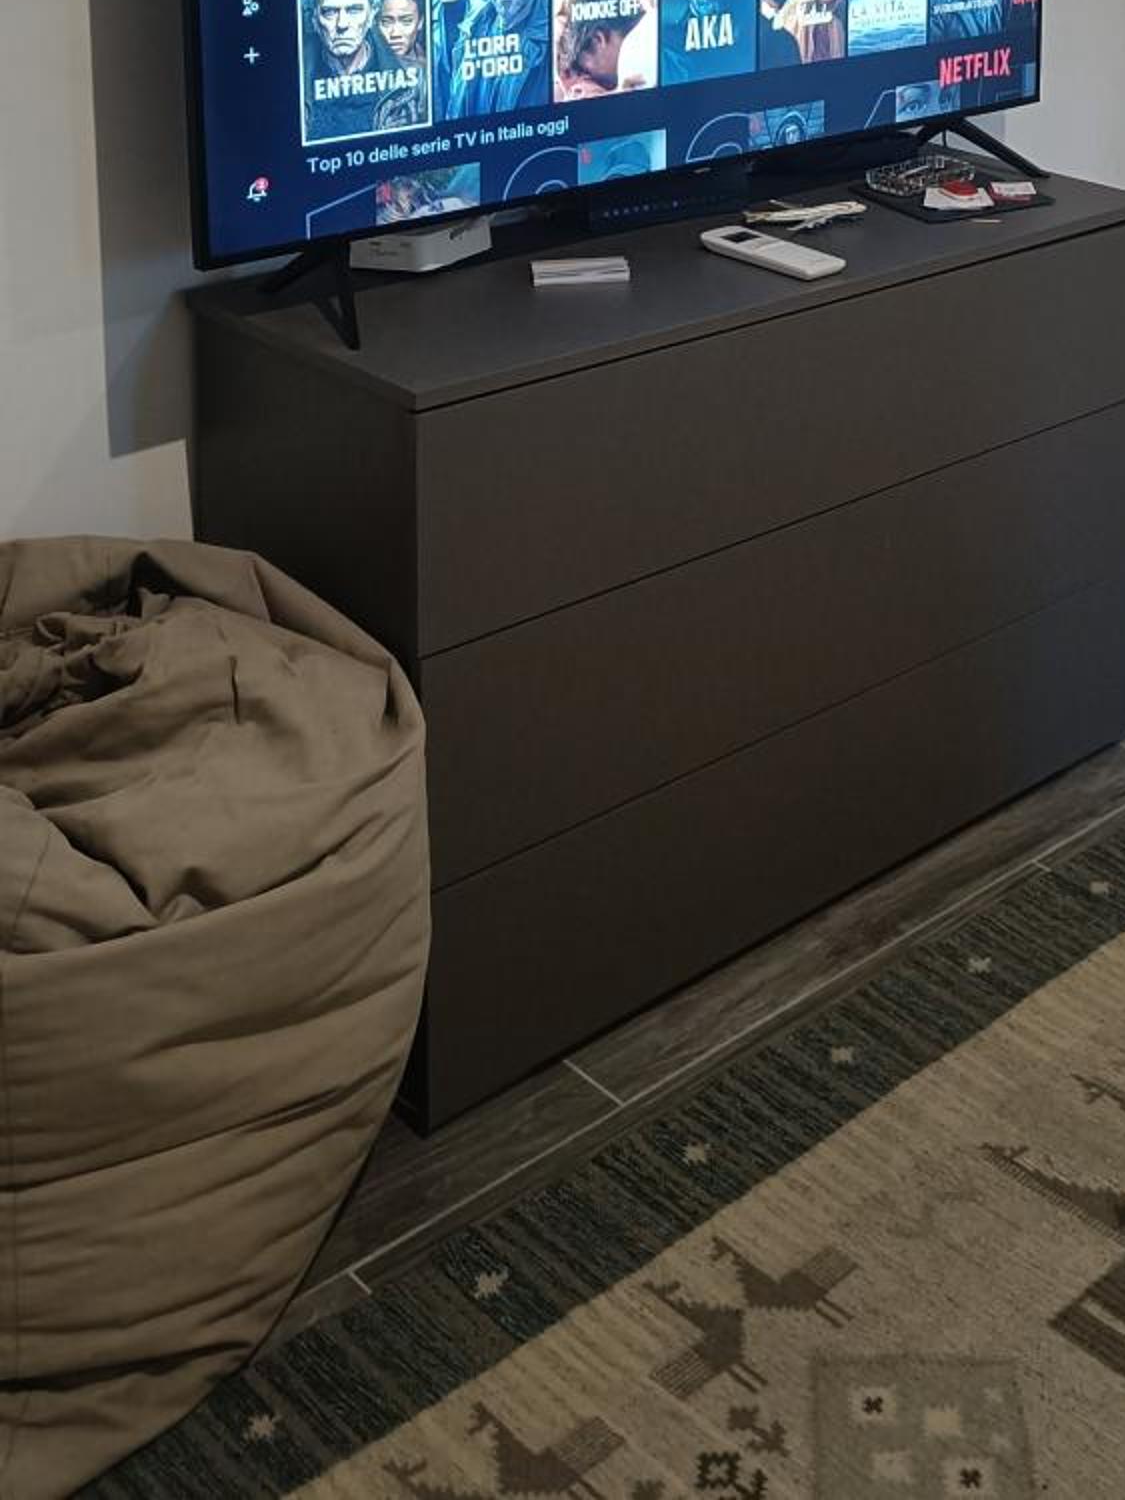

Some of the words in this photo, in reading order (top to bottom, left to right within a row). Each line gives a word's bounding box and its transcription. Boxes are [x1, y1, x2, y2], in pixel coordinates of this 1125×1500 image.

[464, 33, 519, 59] L'ORA
[685, 13, 734, 51] AKA
[462, 54, 523, 81] D'ORO
[939, 47, 1011, 88] NETFLIX
[307, 155, 341, 174] Top
[345, 150, 365, 166] 10
[369, 143, 409, 163] delle
[412, 138, 450, 157] serie
[454, 133, 477, 149] TV
[481, 131, 494, 144] in
[497, 124, 534, 142] Italia
[537, 116, 569, 137] oggi
